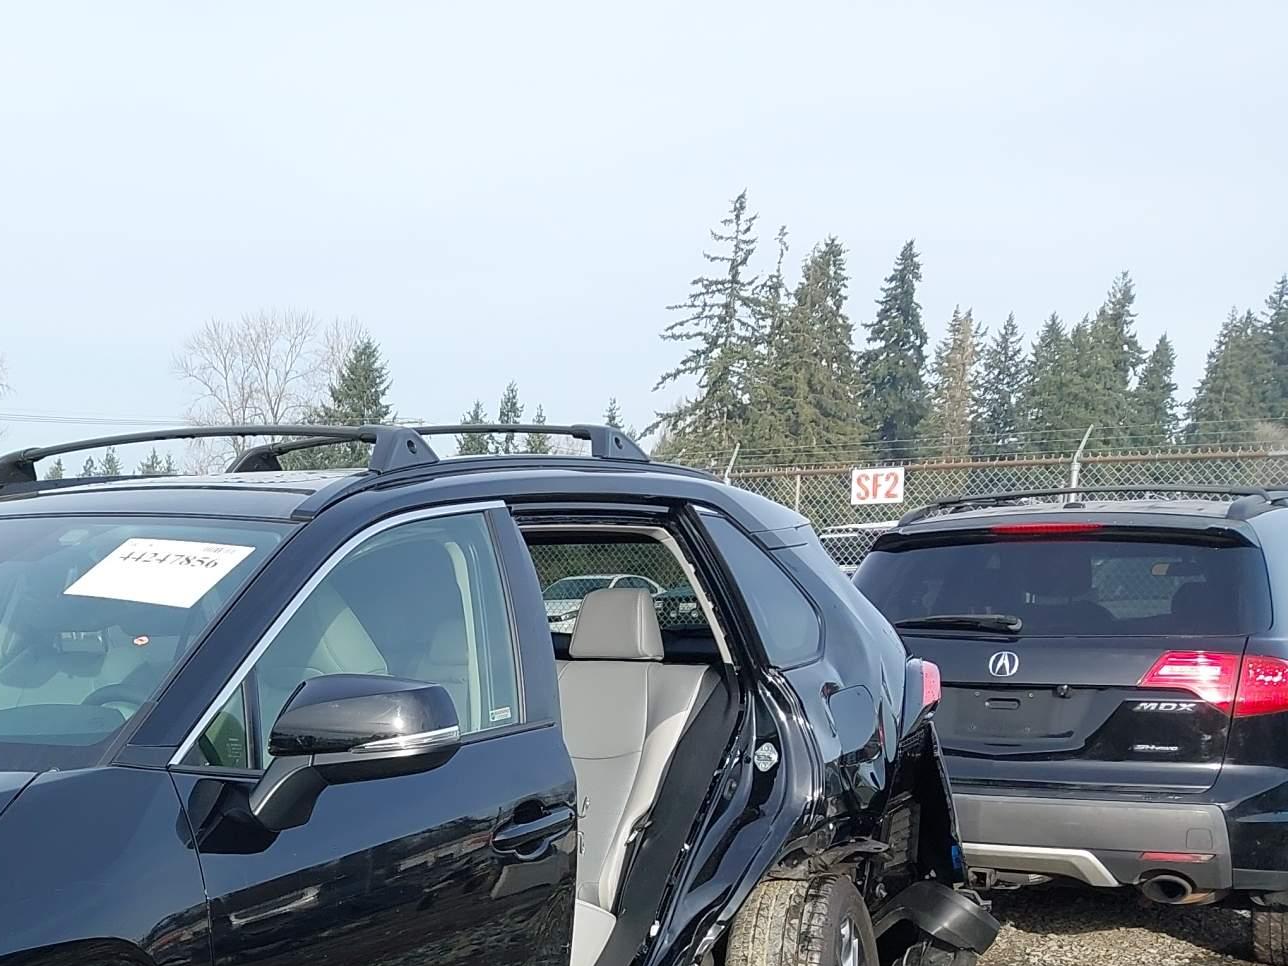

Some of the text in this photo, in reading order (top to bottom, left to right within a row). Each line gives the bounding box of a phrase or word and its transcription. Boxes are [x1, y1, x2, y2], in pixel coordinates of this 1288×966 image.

[856, 472, 899, 500] SF2
[119, 551, 219, 569] 44247856
[1132, 702, 1197, 712] MDX
